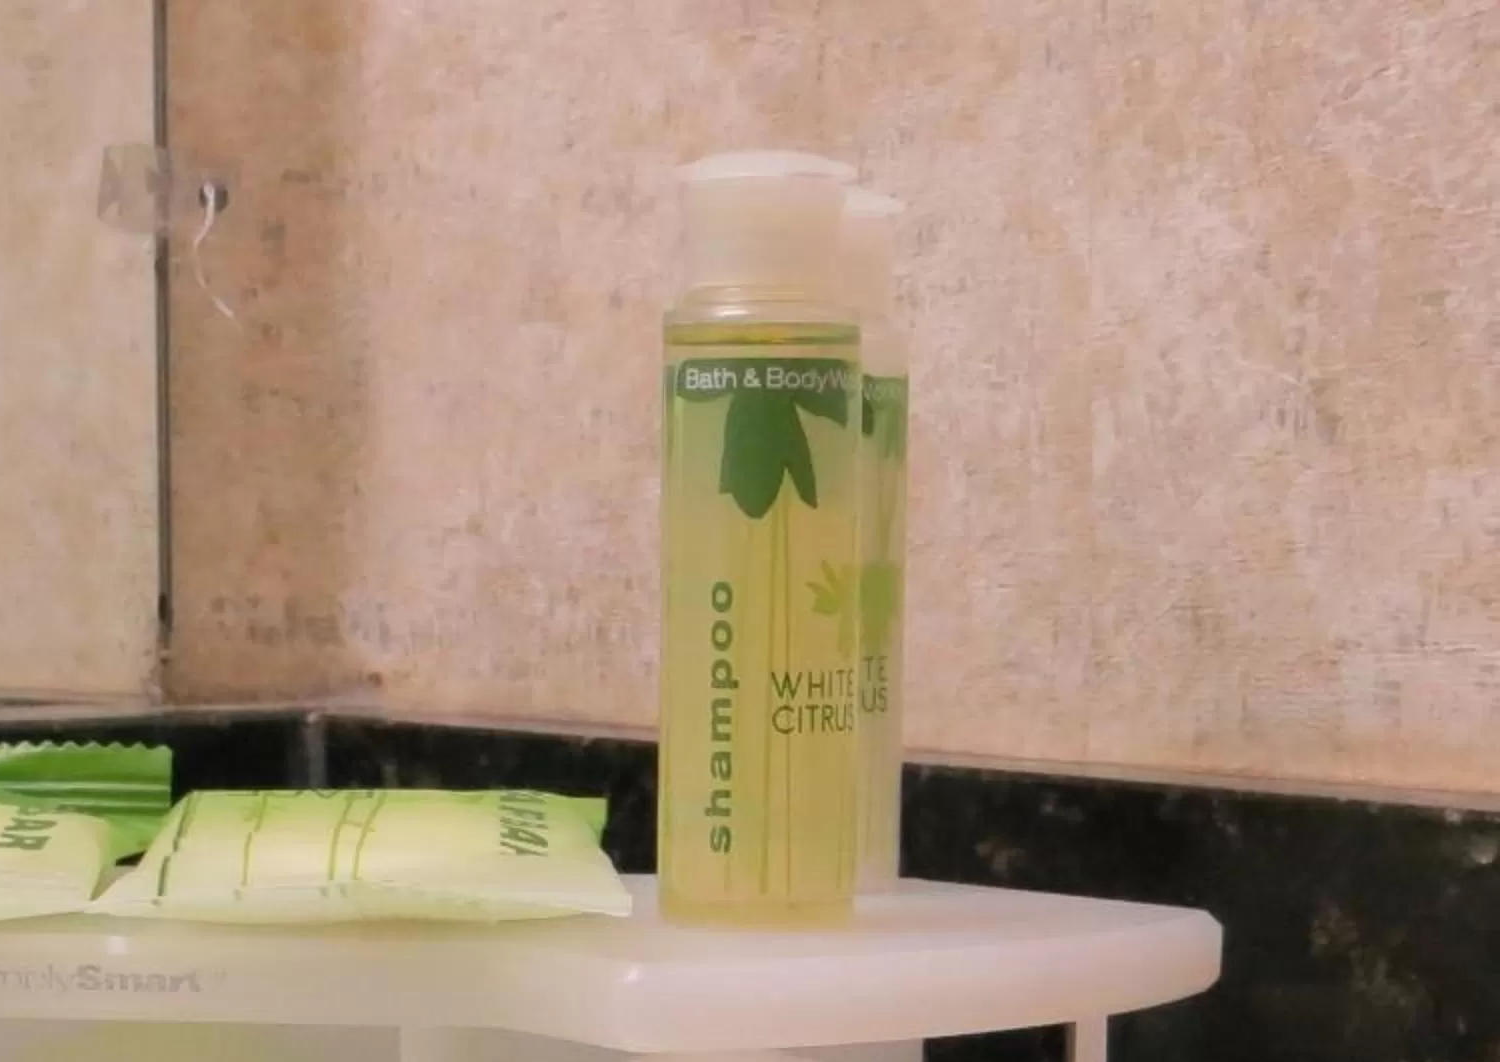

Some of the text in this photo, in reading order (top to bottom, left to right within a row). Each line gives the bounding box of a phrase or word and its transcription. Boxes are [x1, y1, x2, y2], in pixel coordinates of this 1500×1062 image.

[685, 367, 737, 390] Bath
[744, 367, 762, 389] &
[770, 668, 855, 700] WHITE
[704, 581, 739, 854] shampoo
[771, 703, 854, 735] CITRUS
